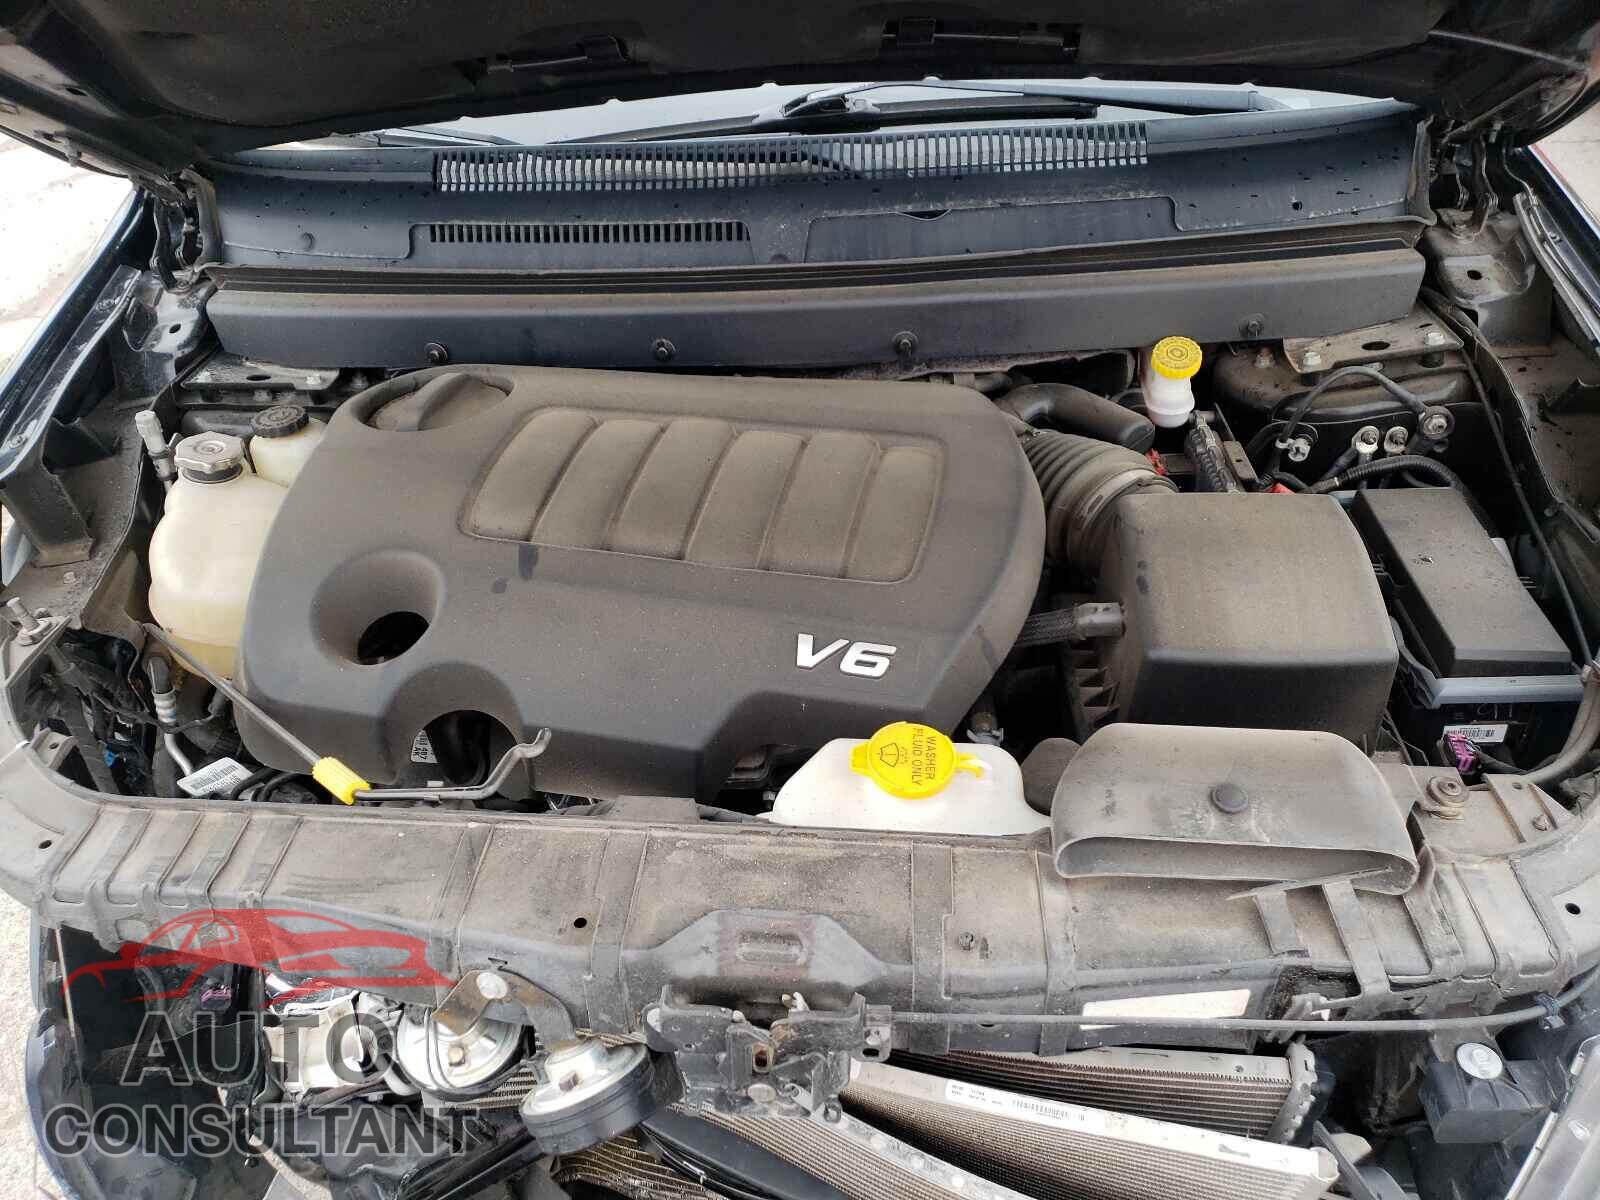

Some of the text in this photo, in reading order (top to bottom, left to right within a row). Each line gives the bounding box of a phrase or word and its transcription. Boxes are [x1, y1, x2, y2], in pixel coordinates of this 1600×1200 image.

[795, 632, 897, 679] V6
[911, 727, 924, 787] FLUID ONLY
[925, 736, 937, 780] WASHER
